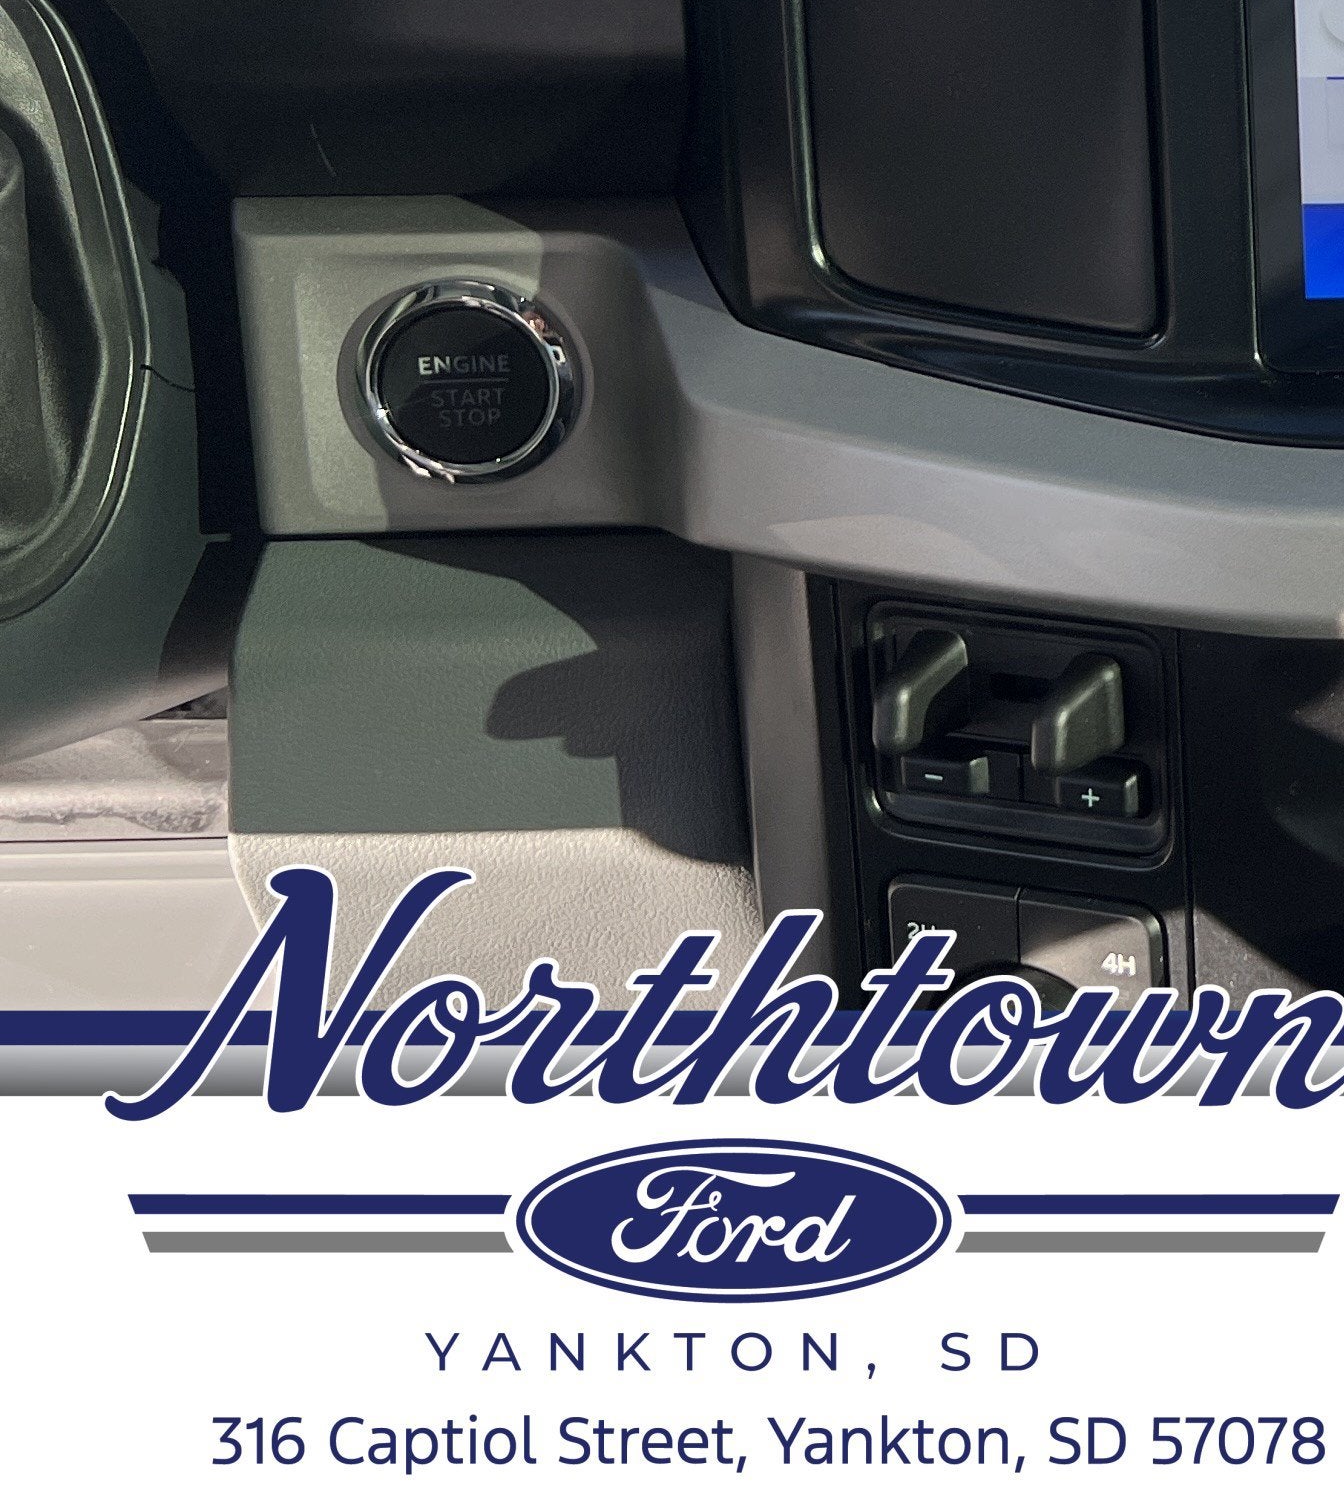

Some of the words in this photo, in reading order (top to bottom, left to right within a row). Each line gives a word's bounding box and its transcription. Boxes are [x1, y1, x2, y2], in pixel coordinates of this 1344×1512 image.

[417, 354, 512, 376] ENGINE
[431, 388, 505, 408] START
[438, 408, 501, 428] STOP
[1101, 952, 1136, 976] 4H
